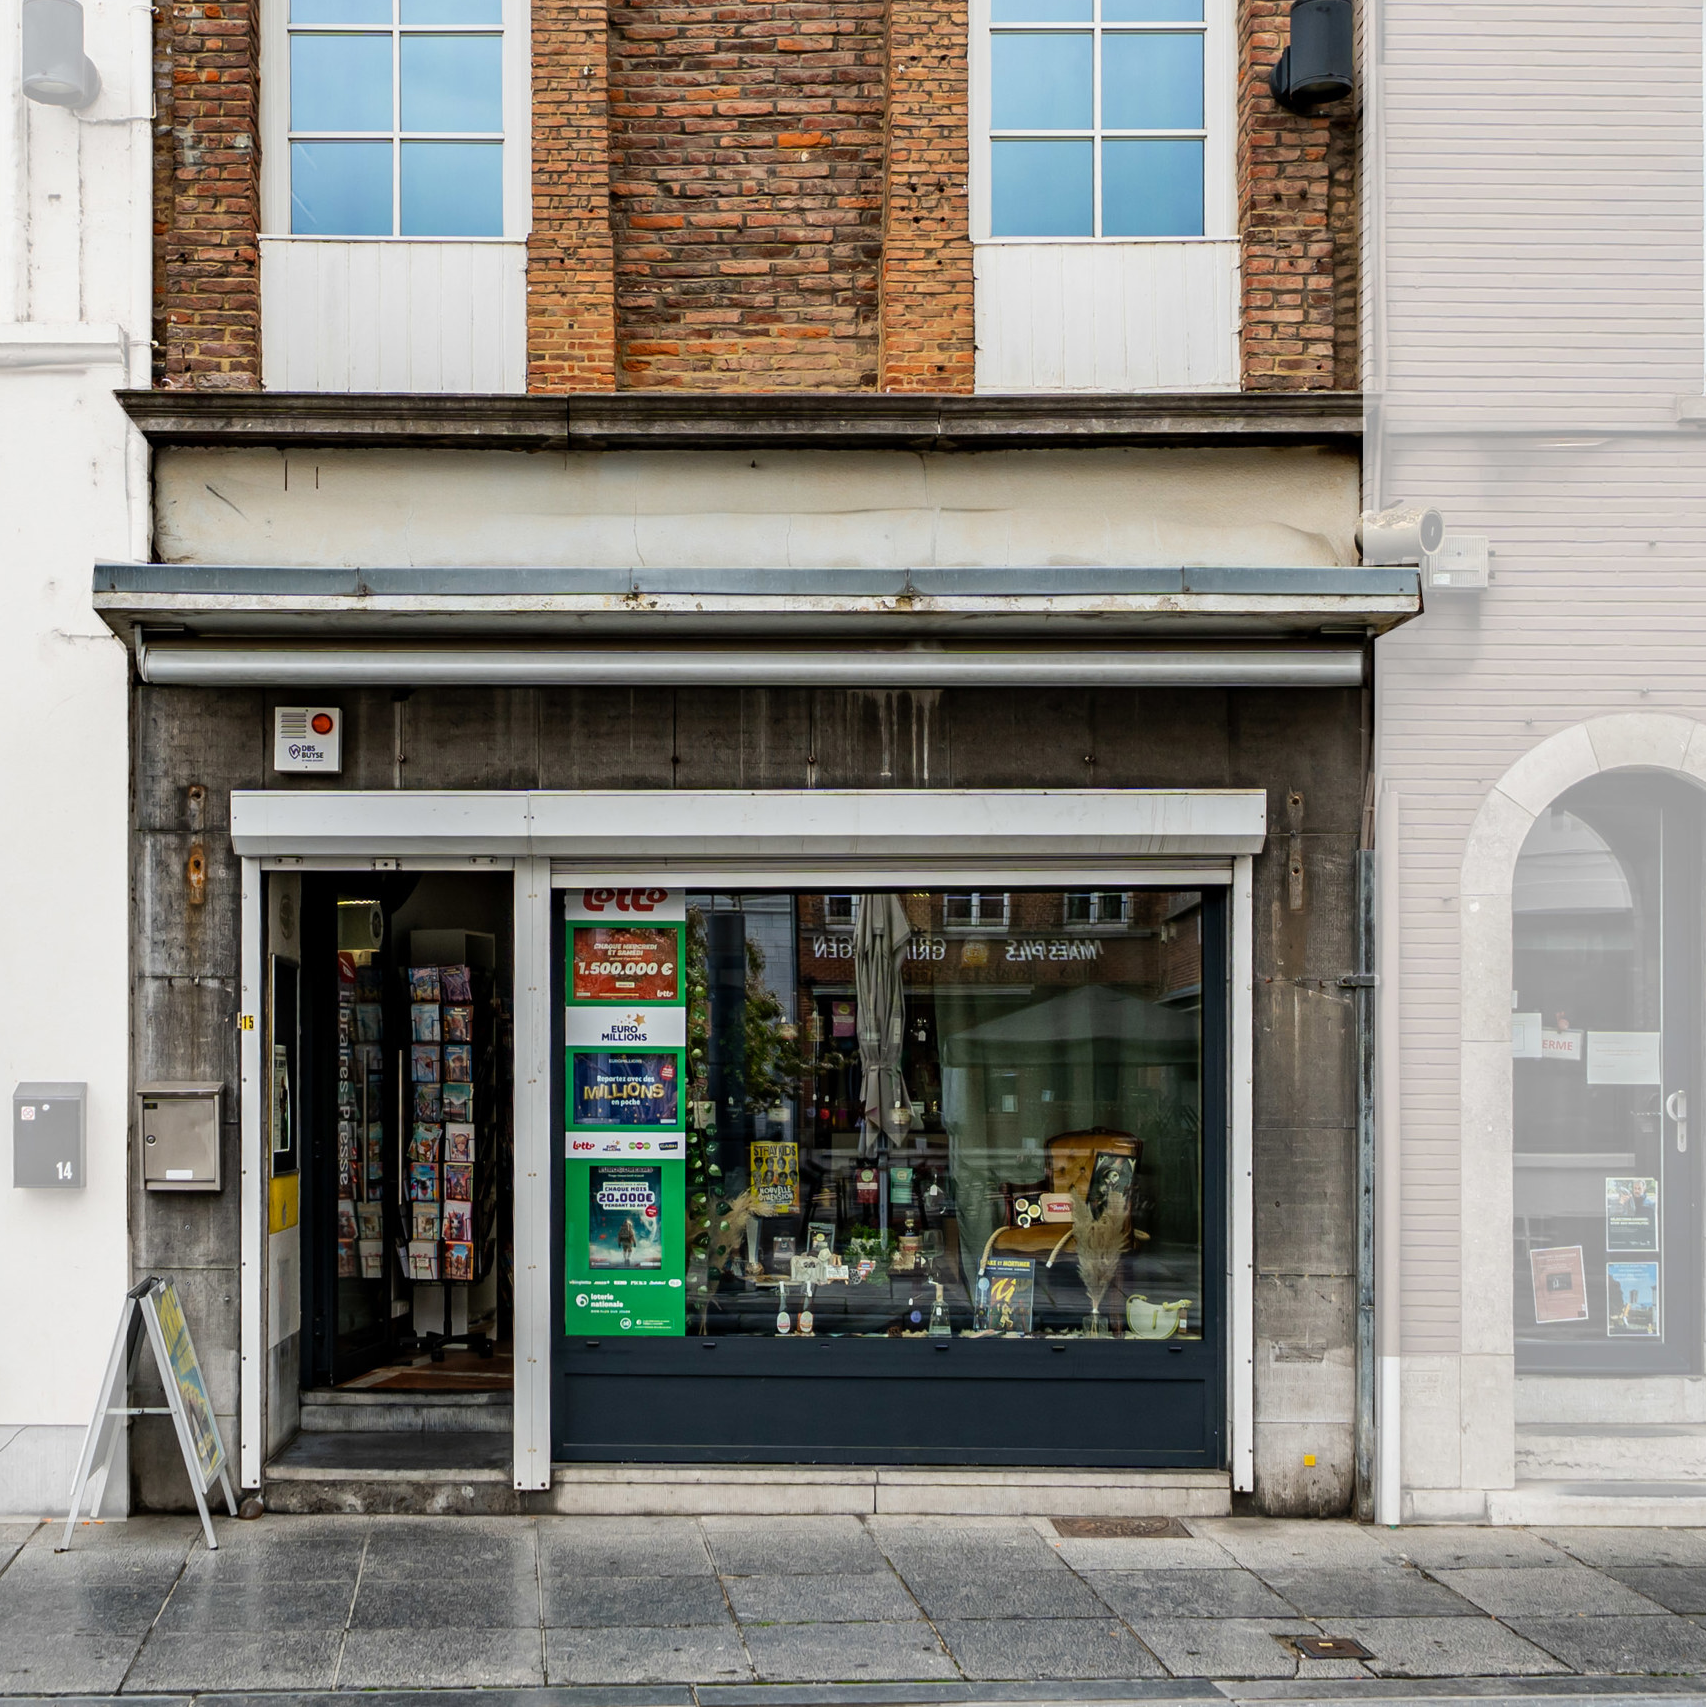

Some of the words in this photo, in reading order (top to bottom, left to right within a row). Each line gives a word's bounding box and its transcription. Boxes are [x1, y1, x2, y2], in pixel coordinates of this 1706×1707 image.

[578, 962, 658, 976] 1.500.000
[661, 962, 673, 976] €
[243, 1015, 254, 1029] 15
[611, 1025, 638, 1033] EURO
[601, 1033, 648, 1041] MILLIONS
[1542, 1039, 1573, 1051] ERME
[583, 1082, 665, 1100] MILLIONS
[620, 1098, 641, 1106] poche
[573, 1141, 595, 1150] lotto
[56, 1161, 73, 1180] 14
[598, 1193, 653, 1202] 20.000€
